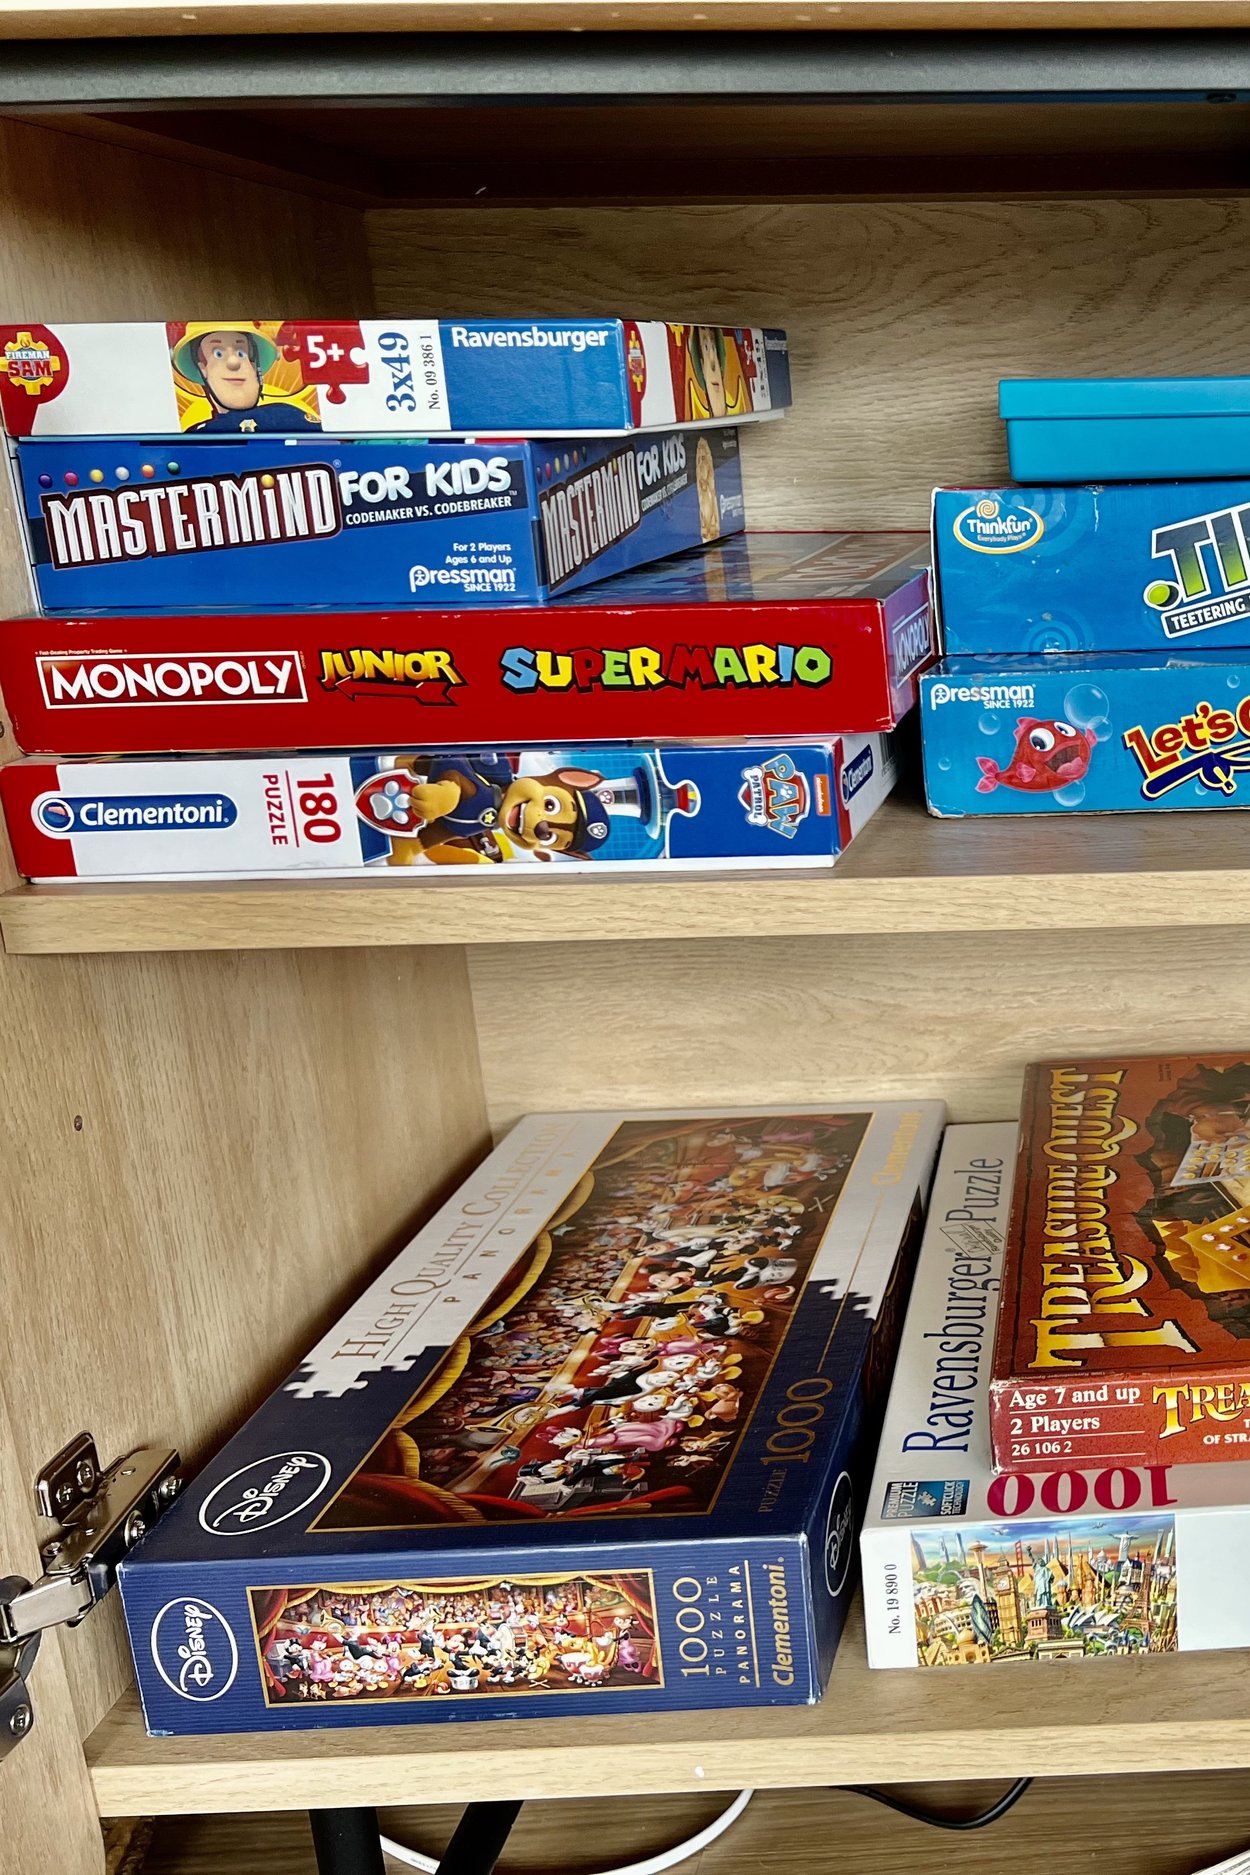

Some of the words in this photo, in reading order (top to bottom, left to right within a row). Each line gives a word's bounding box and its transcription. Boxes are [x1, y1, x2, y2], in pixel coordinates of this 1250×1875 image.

[5, 350, 50, 360] FIREMAN
[306, 334, 344, 369] 5+
[451, 326, 608, 352] Ravensburger
[7, 359, 52, 377] SAM
[377, 331, 417, 412] 3x49
[425, 370, 438, 385] 09
[428, 389, 441, 410] No.
[339, 466, 413, 506] FOR
[425, 457, 511, 497] KIDS
[346, 507, 414, 525] CODEMAKER
[415, 505, 433, 517] VS.
[434, 496, 512, 514] CODEBREAKER
[445, 556, 468, 565] Ages
[499, 555, 512, 565] Up
[453, 543, 468, 551] For
[470, 543, 476, 551] 2
[478, 543, 511, 553] Players
[464, 584, 492, 592] SINCE
[494, 583, 516, 592] 1922
[1171, 597, 1246, 630] TEETERING
[51, 660, 292, 699] MONOPOLY
[321, 650, 456, 685] JUNIOR
[501, 647, 664, 688] SUPER
[668, 644, 833, 688] MARIO
[983, 700, 1011, 709] SINCE
[1013, 700, 1035, 708] 1922
[1127, 702, 1235, 775] Let's
[80, 800, 223, 826] Clementoni
[262, 774, 288, 846] PUZZLE
[297, 773, 341, 843] 180
[750, 775, 762, 818] PATROL
[762, 754, 798, 839] PAW
[1043, 1067, 1138, 1162] QUEST
[945, 1157, 1004, 1223] Puzzle
[1027, 1164, 1204, 1368] TREASURE
[332, 1302, 420, 1360] HIGH
[390, 1221, 484, 1296] QUALITY
[902, 1251, 1001, 1454] Ravensburger
[1009, 1389, 1047, 1409] Age
[1054, 1387, 1063, 1405] 7
[1071, 1384, 1109, 1403] and
[1115, 1388, 1141, 1405] up
[760, 1377, 834, 1466] 1000
[1010, 1420, 1023, 1435] 2
[1031, 1415, 1100, 1436] Players
[1011, 1444, 1031, 1456] 26
[1034, 1442, 1061, 1455] 106
[1063, 1441, 1072, 1453] 2
[1203, 1434, 1221, 1445] OF
[987, 1465, 1178, 1517] 1000
[885, 1563, 897, 1571] 0
[886, 1574, 899, 1595] 890
[888, 1598, 900, 1612] 19
[672, 1576, 710, 1677] 1000
[706, 1576, 727, 1675] PUZZLE
[728, 1565, 751, 1684] PANORAMA
[763, 1563, 795, 1686] Clementoni
[889, 1615, 902, 1634] No.
